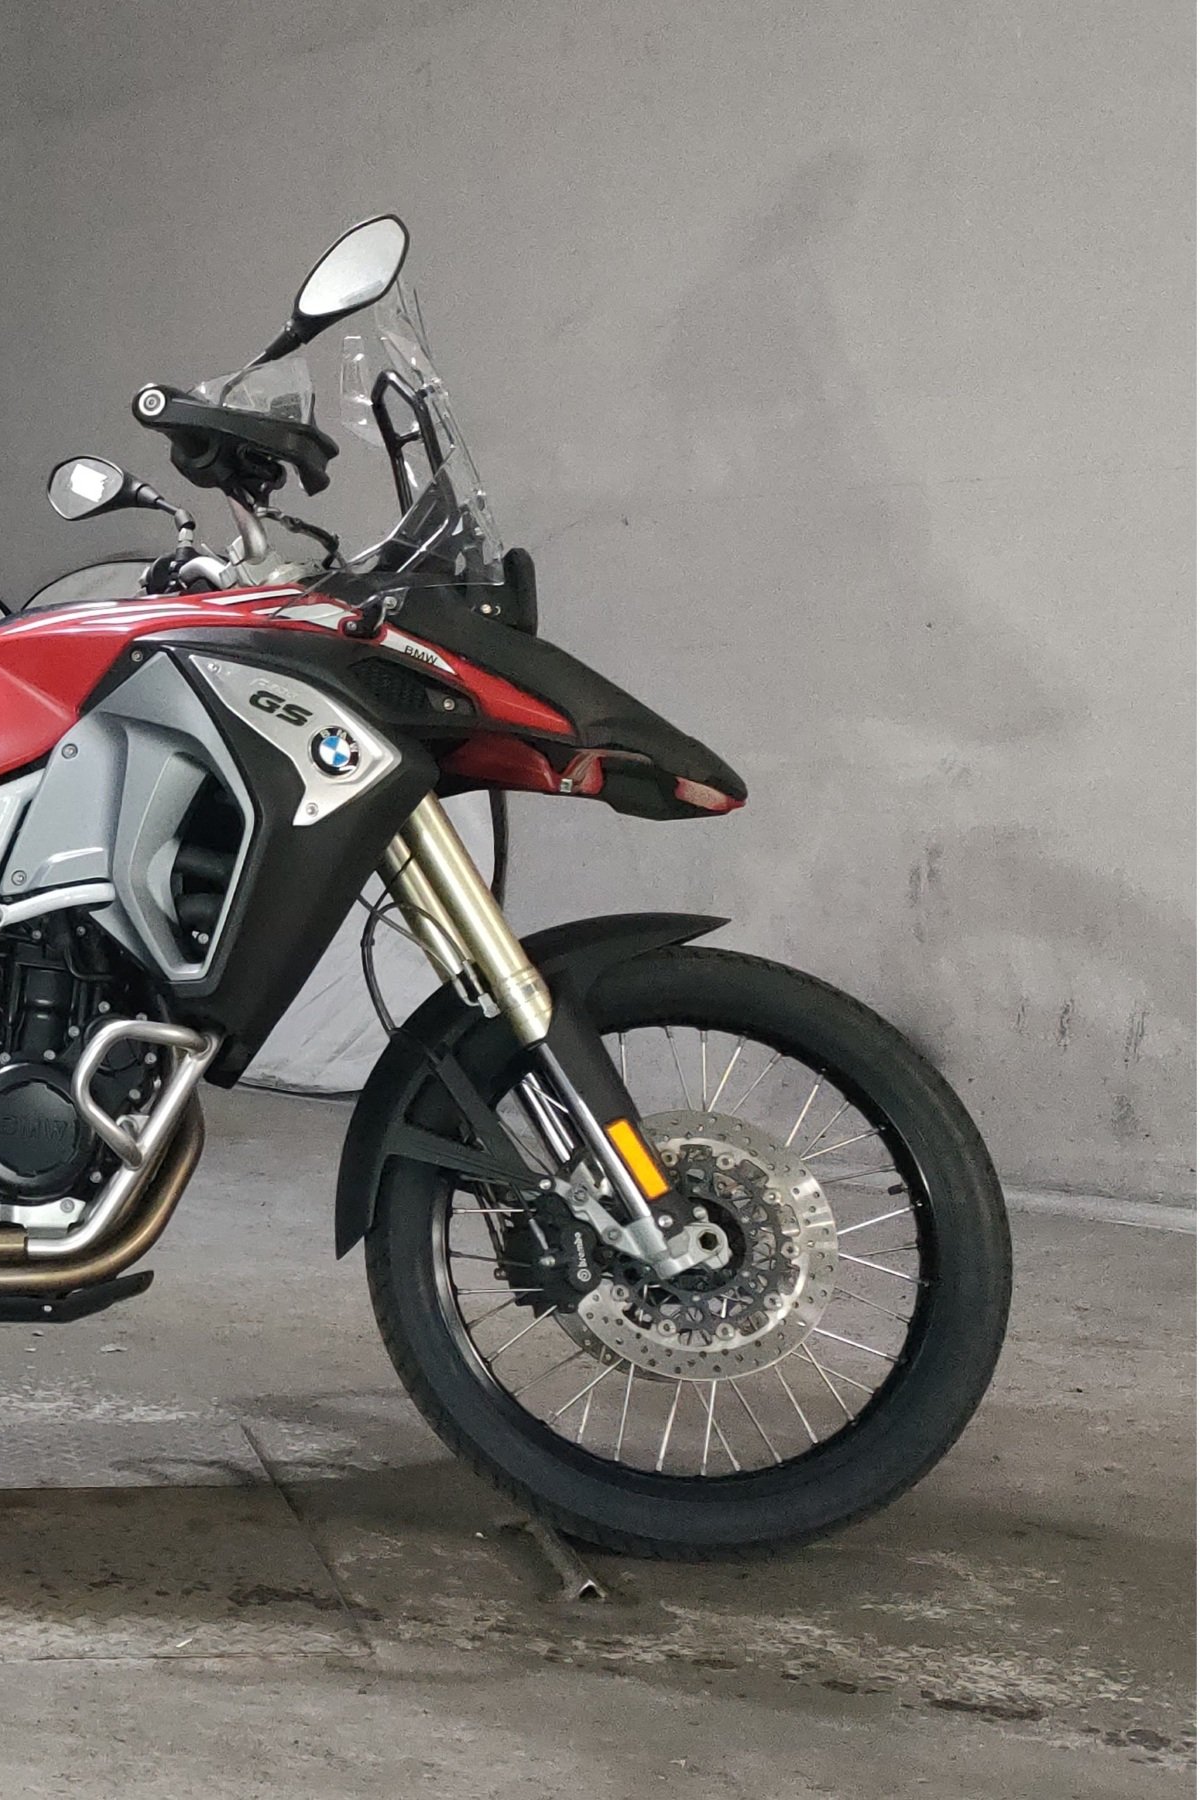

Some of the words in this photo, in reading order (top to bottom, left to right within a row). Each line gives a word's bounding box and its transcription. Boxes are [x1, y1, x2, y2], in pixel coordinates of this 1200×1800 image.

[404, 645, 438, 665] BMW
[249, 690, 313, 727] GS
[0, 1113, 68, 1141] BMW
